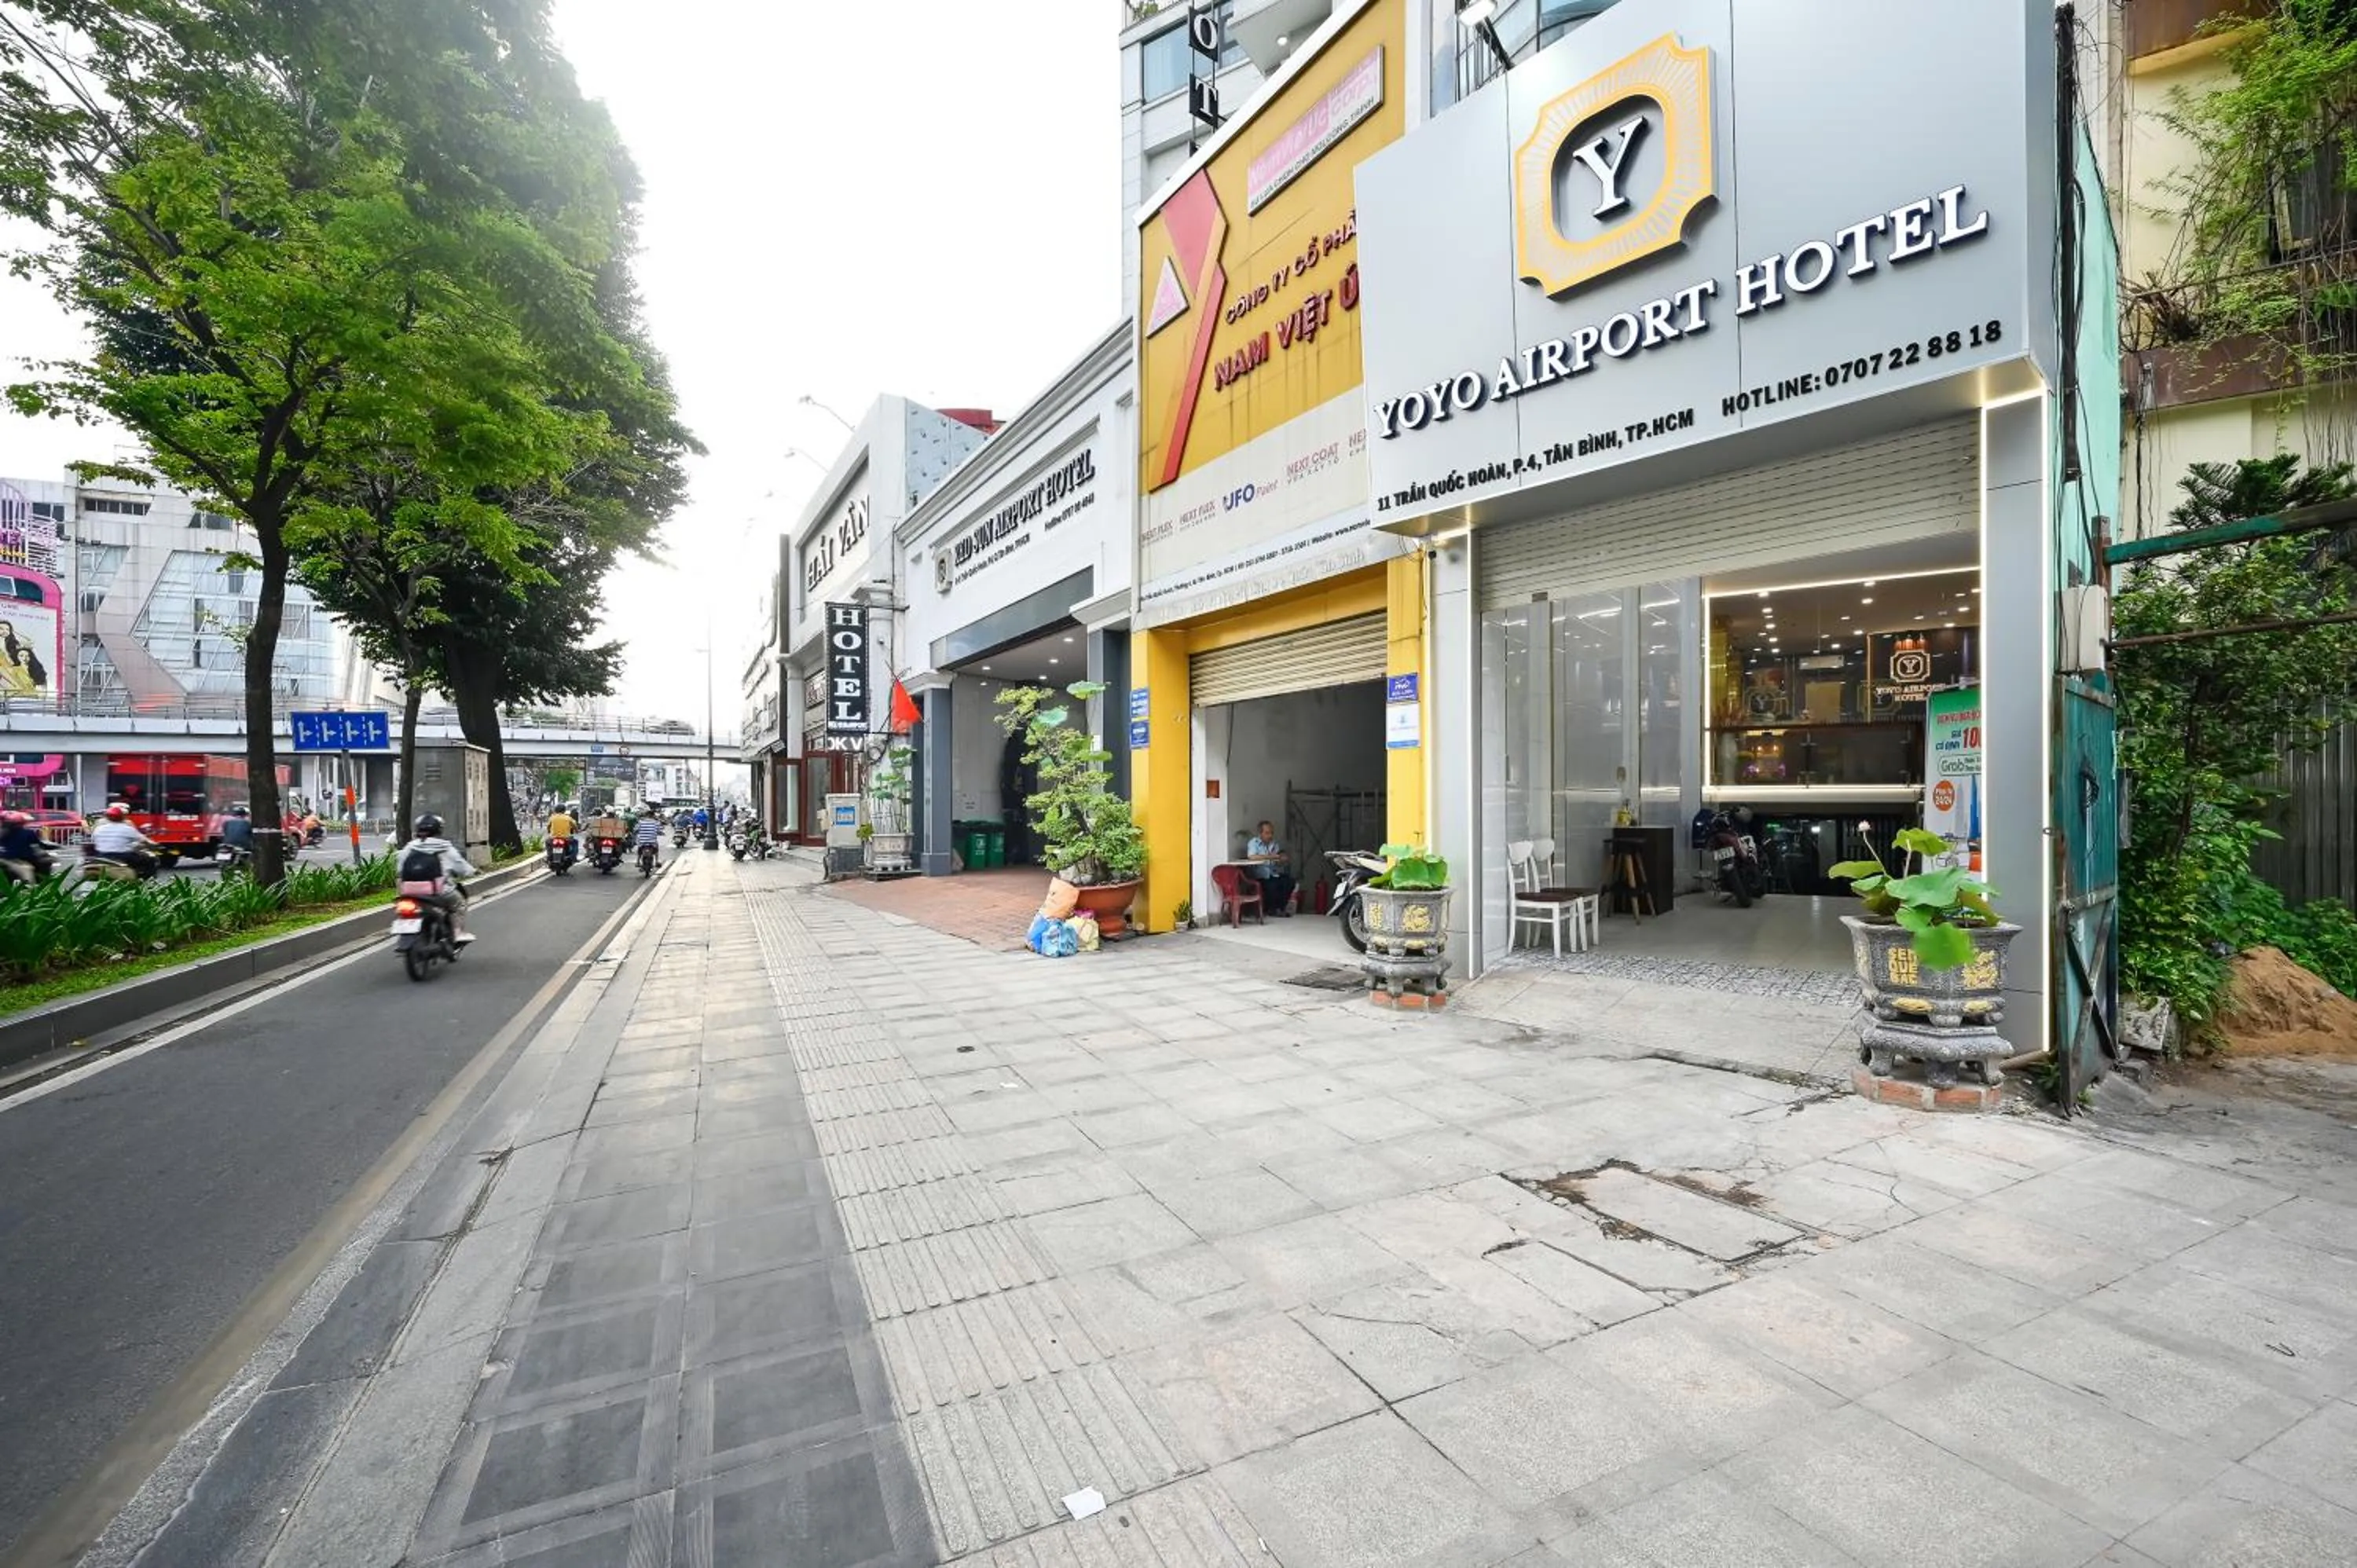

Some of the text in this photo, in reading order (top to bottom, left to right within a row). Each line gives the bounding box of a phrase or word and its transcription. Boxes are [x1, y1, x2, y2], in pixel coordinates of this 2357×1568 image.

[1573, 115, 1648, 222] Y
[1226, 284, 1270, 324] CÔNG
[1272, 266, 1290, 293] TY
[1322, 209, 1358, 257] PHẦ
[1373, 184, 1989, 439] YOYO AIRPORT HOTEL
[1215, 262, 1360, 392] NAM VIỆT Ú
[1721, 319, 2002, 416] HOTLINE: 0707 22 88 18
[1046, 449, 1096, 507] HOTEL
[1222, 482, 1255, 512] UFO
[1377, 496, 1391, 511] 11
[1428, 469, 1465, 499] QUỐC
[1468, 461, 1512, 487] HOÀN,
[1512, 454, 1543, 475] P.4,
[1543, 442, 1574, 467] TÂN
[1578, 430, 1623, 456] BÌNH,
[1625, 408, 1695, 443] TP.HCM
[833, 607, 862, 720] HOTEL
